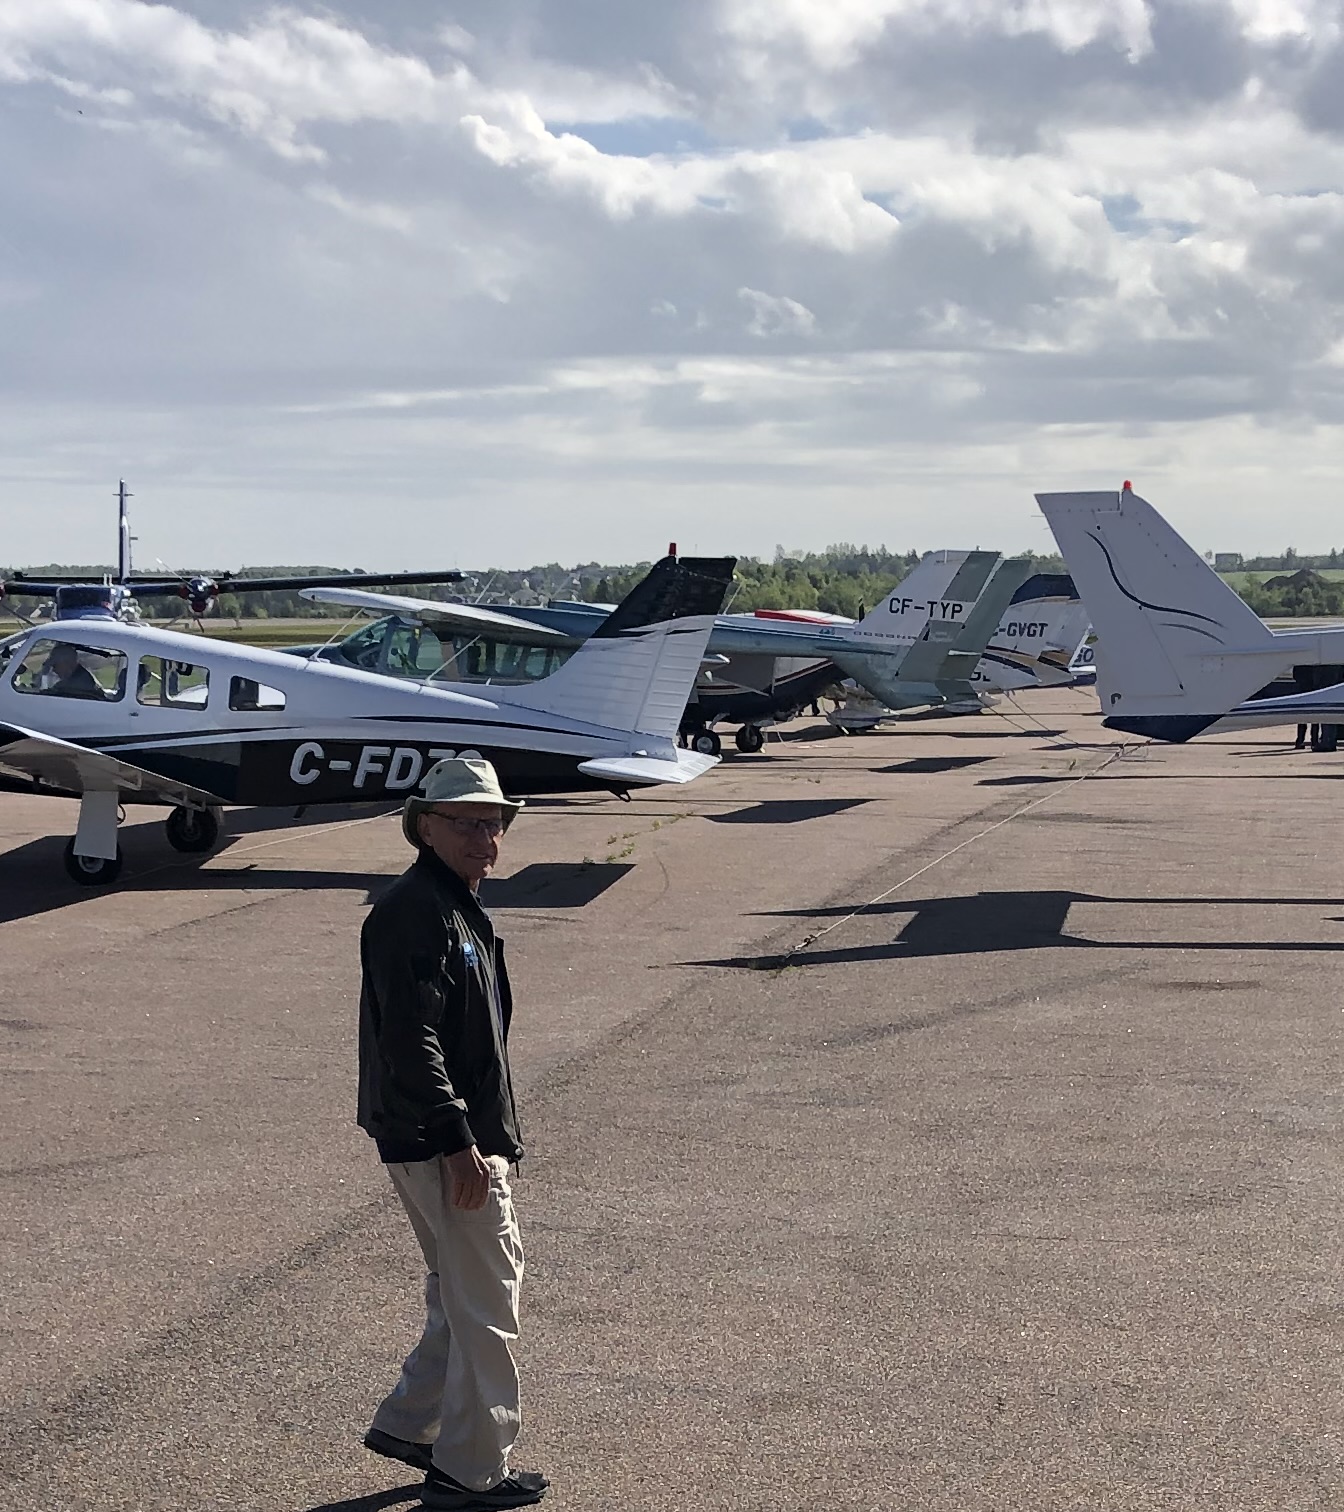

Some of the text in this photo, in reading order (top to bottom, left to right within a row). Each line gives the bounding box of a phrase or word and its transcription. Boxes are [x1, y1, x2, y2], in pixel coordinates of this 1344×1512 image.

[889, 597, 963, 620] CF-TYP
[993, 622, 1049, 638] -GVGT
[290, 742, 483, 791] C-FD
